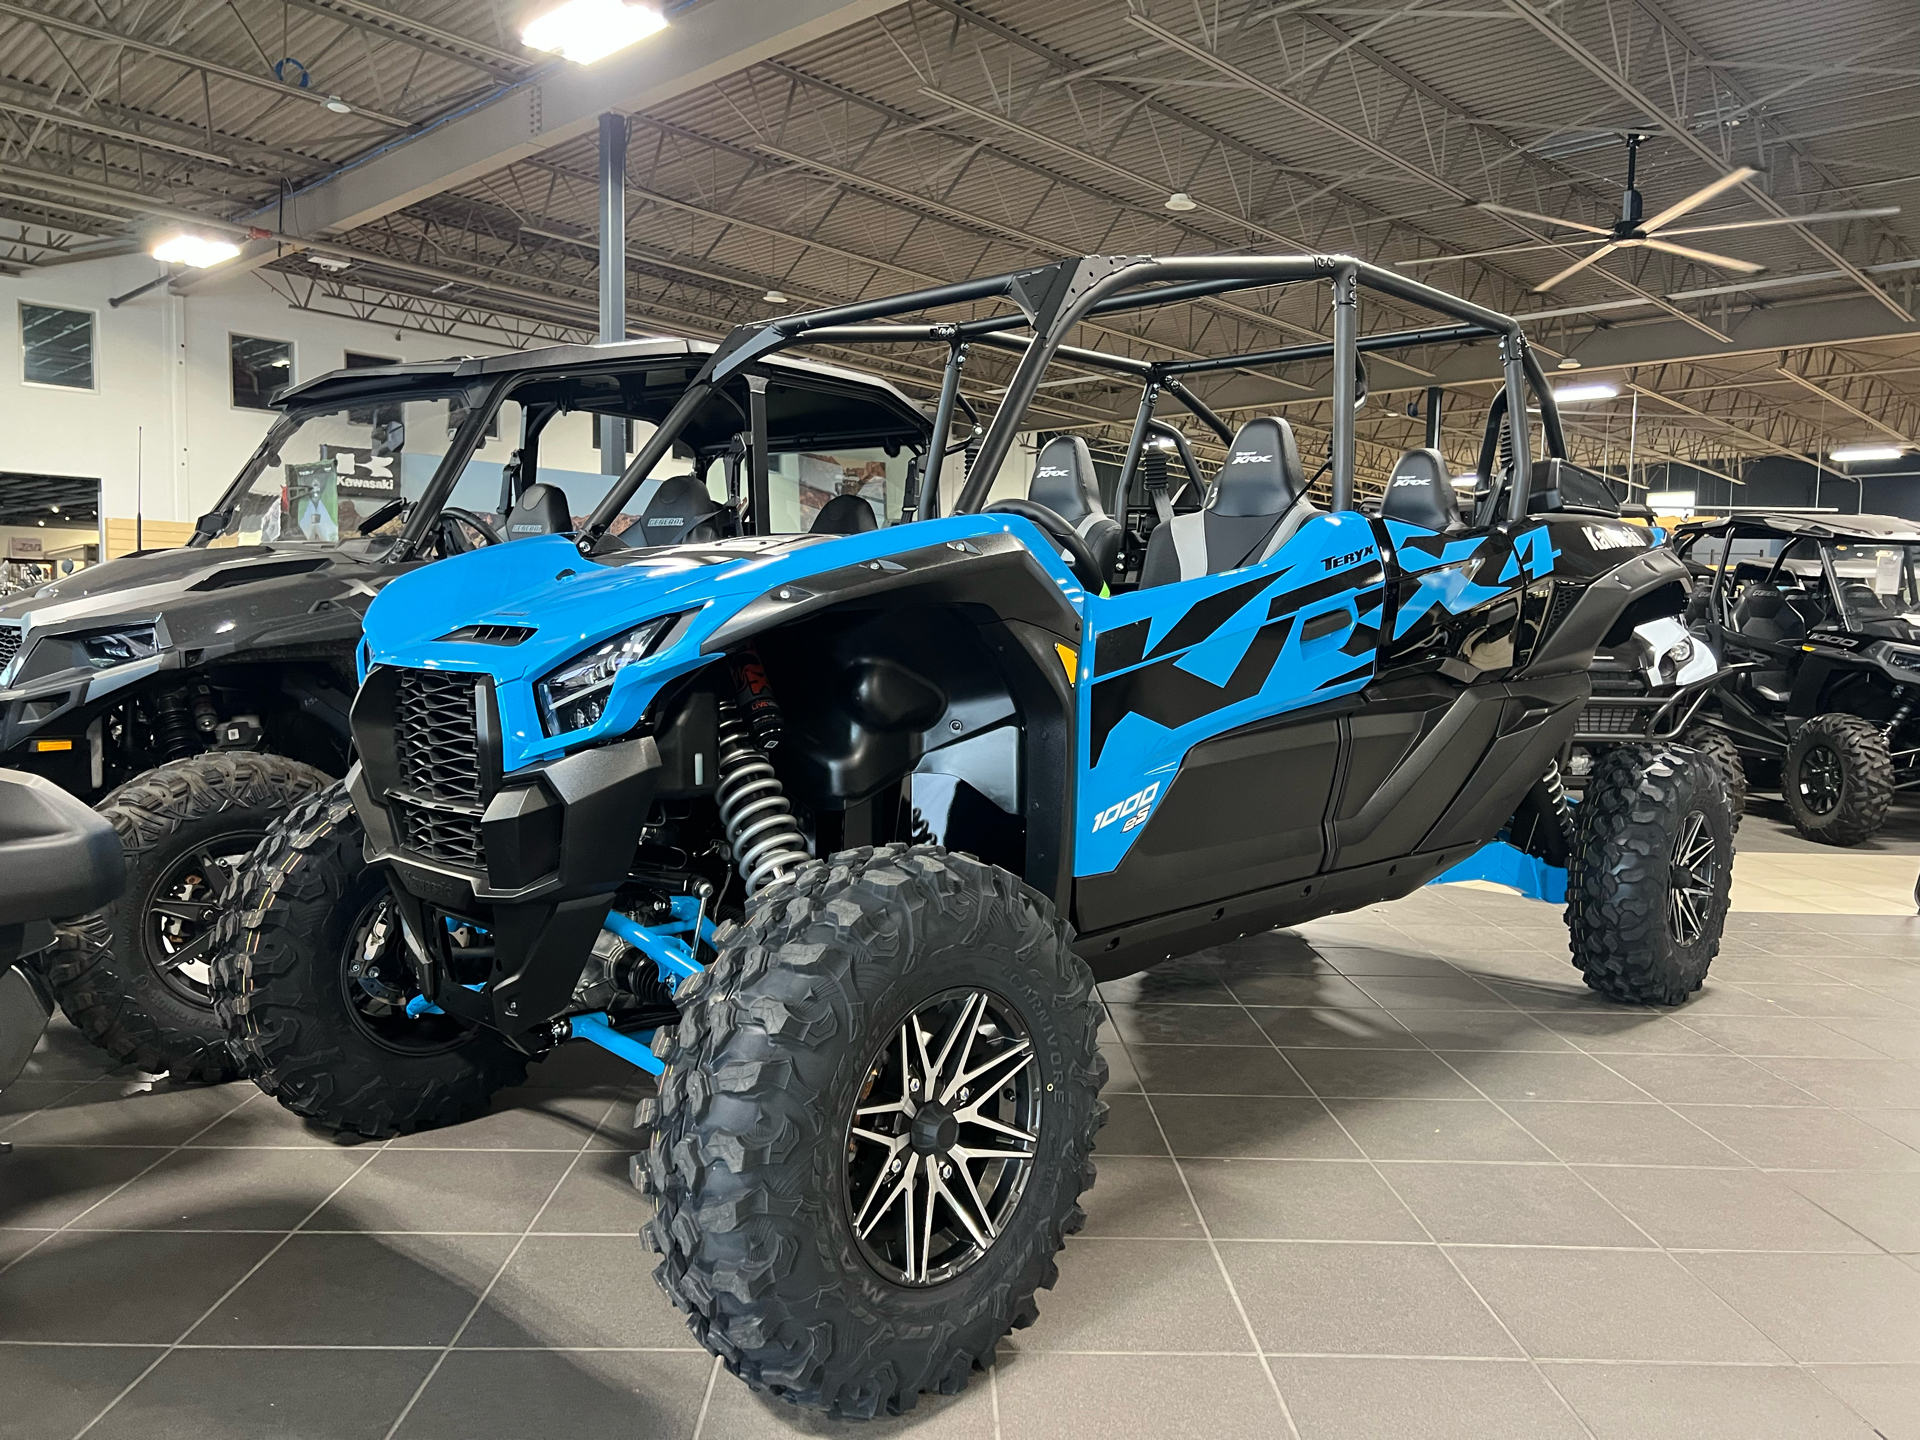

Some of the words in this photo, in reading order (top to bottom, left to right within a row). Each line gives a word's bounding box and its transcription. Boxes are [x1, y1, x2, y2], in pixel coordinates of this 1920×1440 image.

[1231, 455, 1273, 465] KRX
[1036, 469, 1070, 478] KRX
[337, 476, 394, 490] Kawasaki
[1393, 478, 1432, 487] KRX
[648, 518, 684, 527] GENERAL
[1581, 526, 1647, 551] Kawaki
[1091, 780, 1161, 834] 1000
